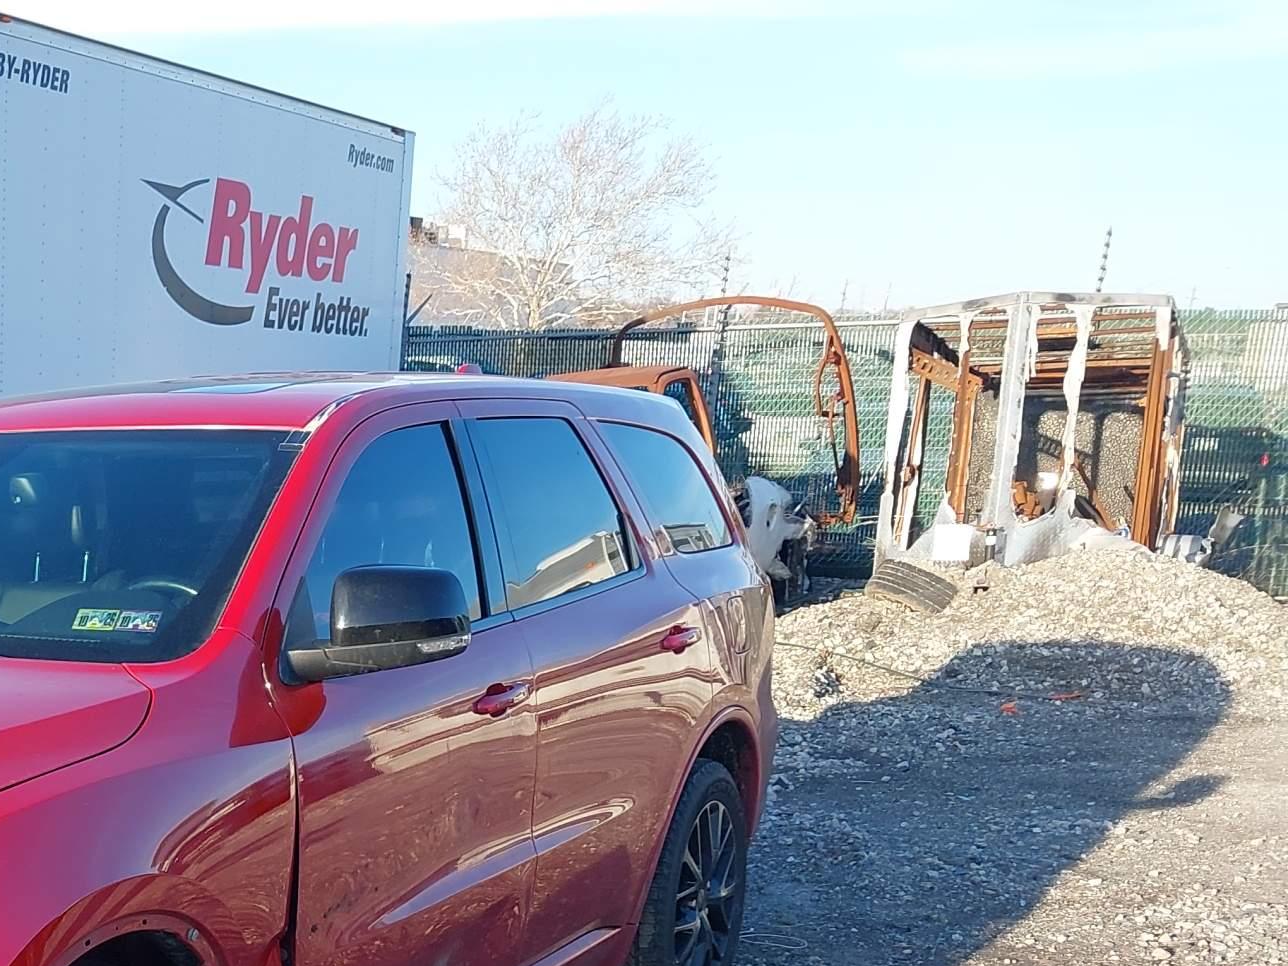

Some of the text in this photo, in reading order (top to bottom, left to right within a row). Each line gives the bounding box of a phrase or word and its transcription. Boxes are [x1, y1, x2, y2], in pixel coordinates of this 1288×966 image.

[347, 143, 395, 173] Ryder.com
[204, 177, 359, 294] Ryder
[263, 286, 370, 337] Ever better.
